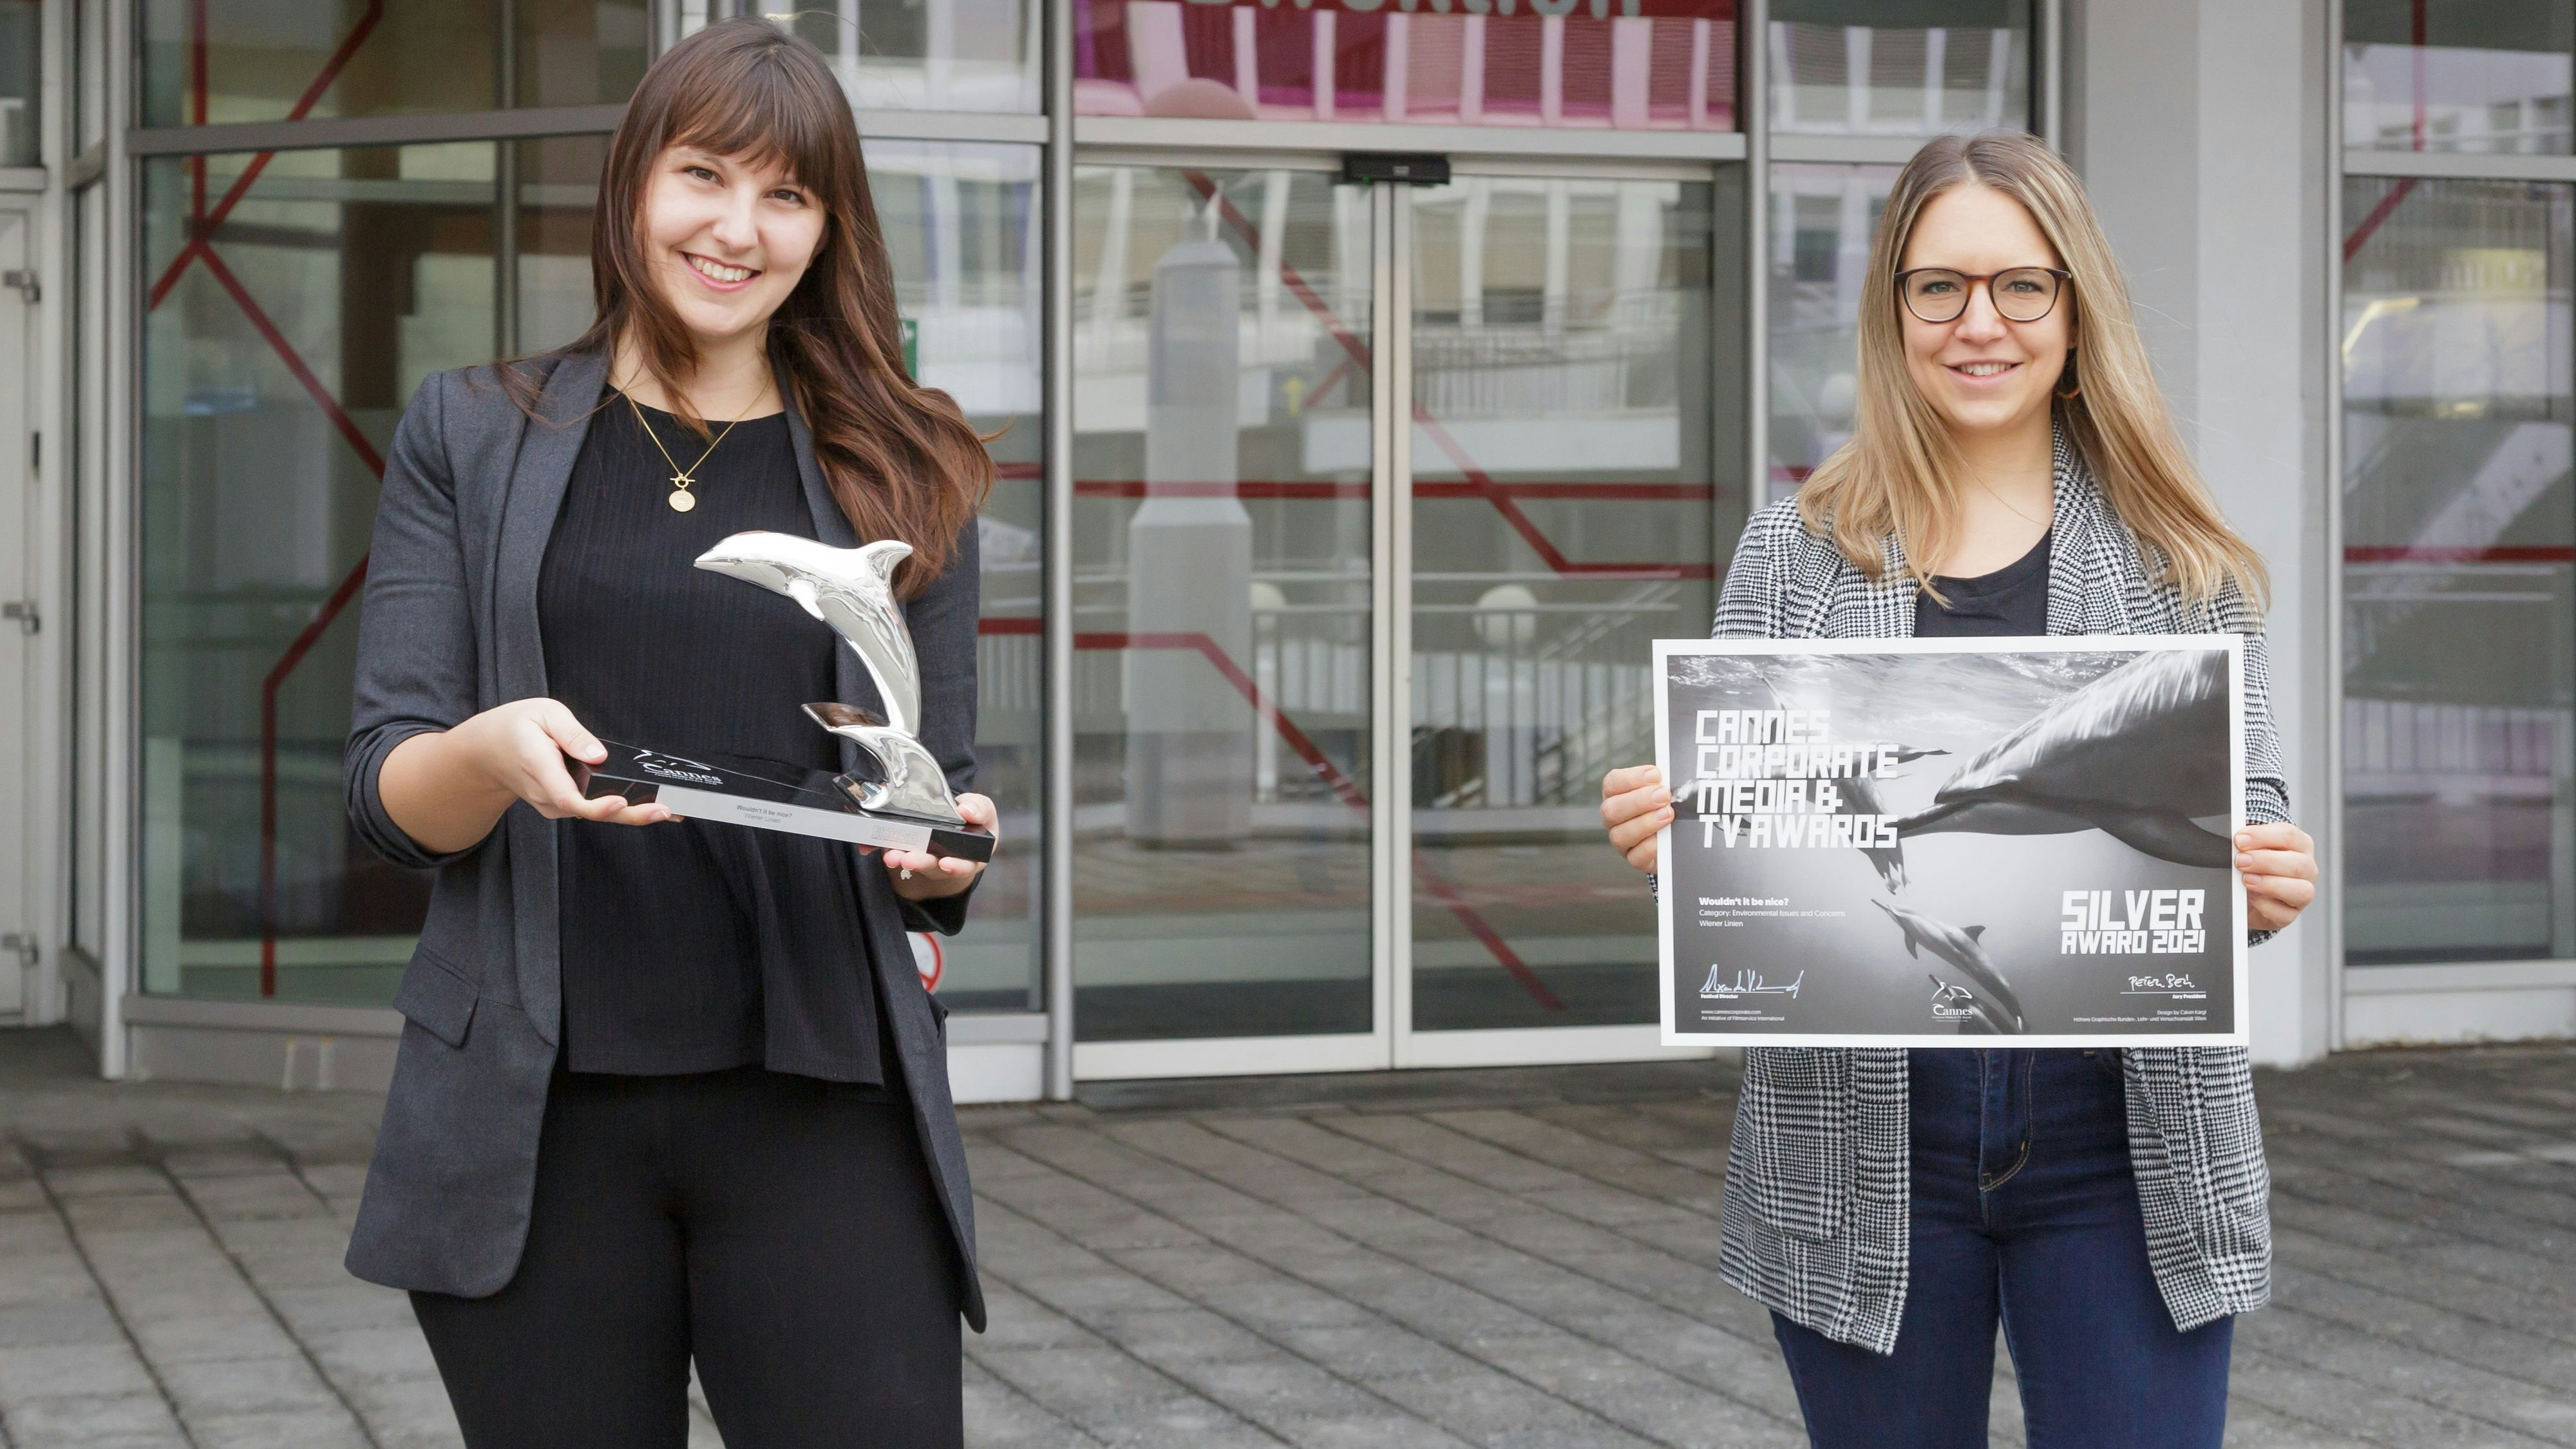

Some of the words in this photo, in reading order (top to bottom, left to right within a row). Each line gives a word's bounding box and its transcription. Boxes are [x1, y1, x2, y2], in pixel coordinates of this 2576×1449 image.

[1696, 710, 1830, 744] CANNES
[638, 761, 722, 781] Cannes
[1696, 744, 1899, 779] CORPORATE
[737, 804, 762, 814] Wouldn't
[1697, 779, 1807, 813] MEDIA
[1815, 779, 1842, 813] &
[1699, 814, 1742, 848] TV
[1749, 814, 1899, 848] AWARDS
[1699, 897, 1741, 905] Wouldn't
[2061, 889, 2205, 931] SILVER
[2061, 931, 2148, 954] AWARD
[2152, 930, 2205, 953] 2021
[1932, 1003, 1973, 1016] Cannes
